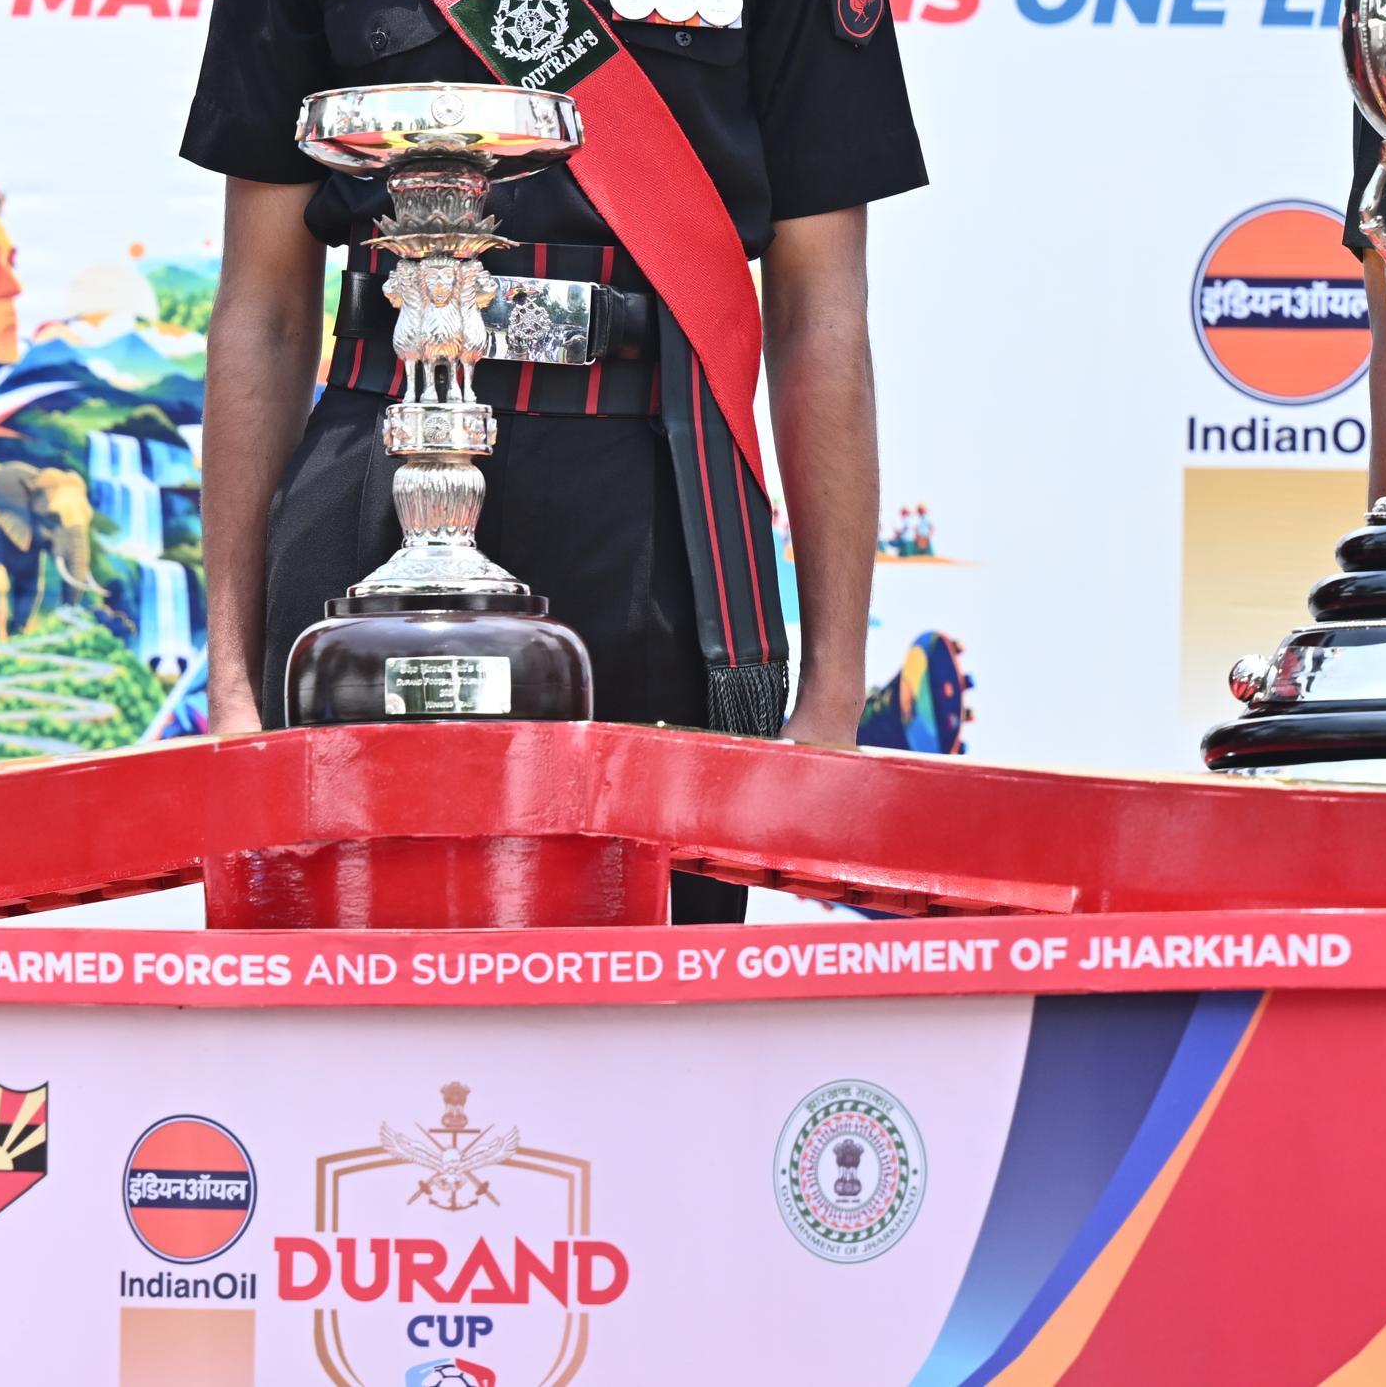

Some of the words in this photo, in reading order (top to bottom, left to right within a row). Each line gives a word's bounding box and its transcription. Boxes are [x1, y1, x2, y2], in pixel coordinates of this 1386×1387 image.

[521, 29, 599, 90] OUTRAM'S
[1188, 417, 1365, 453] IndianO
[134, 953, 291, 986] FORCES
[304, 953, 398, 986] AND
[412, 951, 663, 985] SUPPORTED
[677, 948, 727, 982] BY
[736, 938, 1000, 979] GOVERNMENT
[1010, 937, 1068, 972] OF
[1078, 933, 1352, 969] JHARKHAND
[129, 1172, 248, 1205] इंडियनऑयल
[781, 1185, 841, 1255] GOVERNMENT
[844, 1246, 859, 1255] OF
[862, 1185, 918, 1254] JHARKHAND
[120, 1271, 256, 1299] IndianOil
[274, 1235, 630, 1309] DURAND
[407, 1314, 493, 1348] CUP
